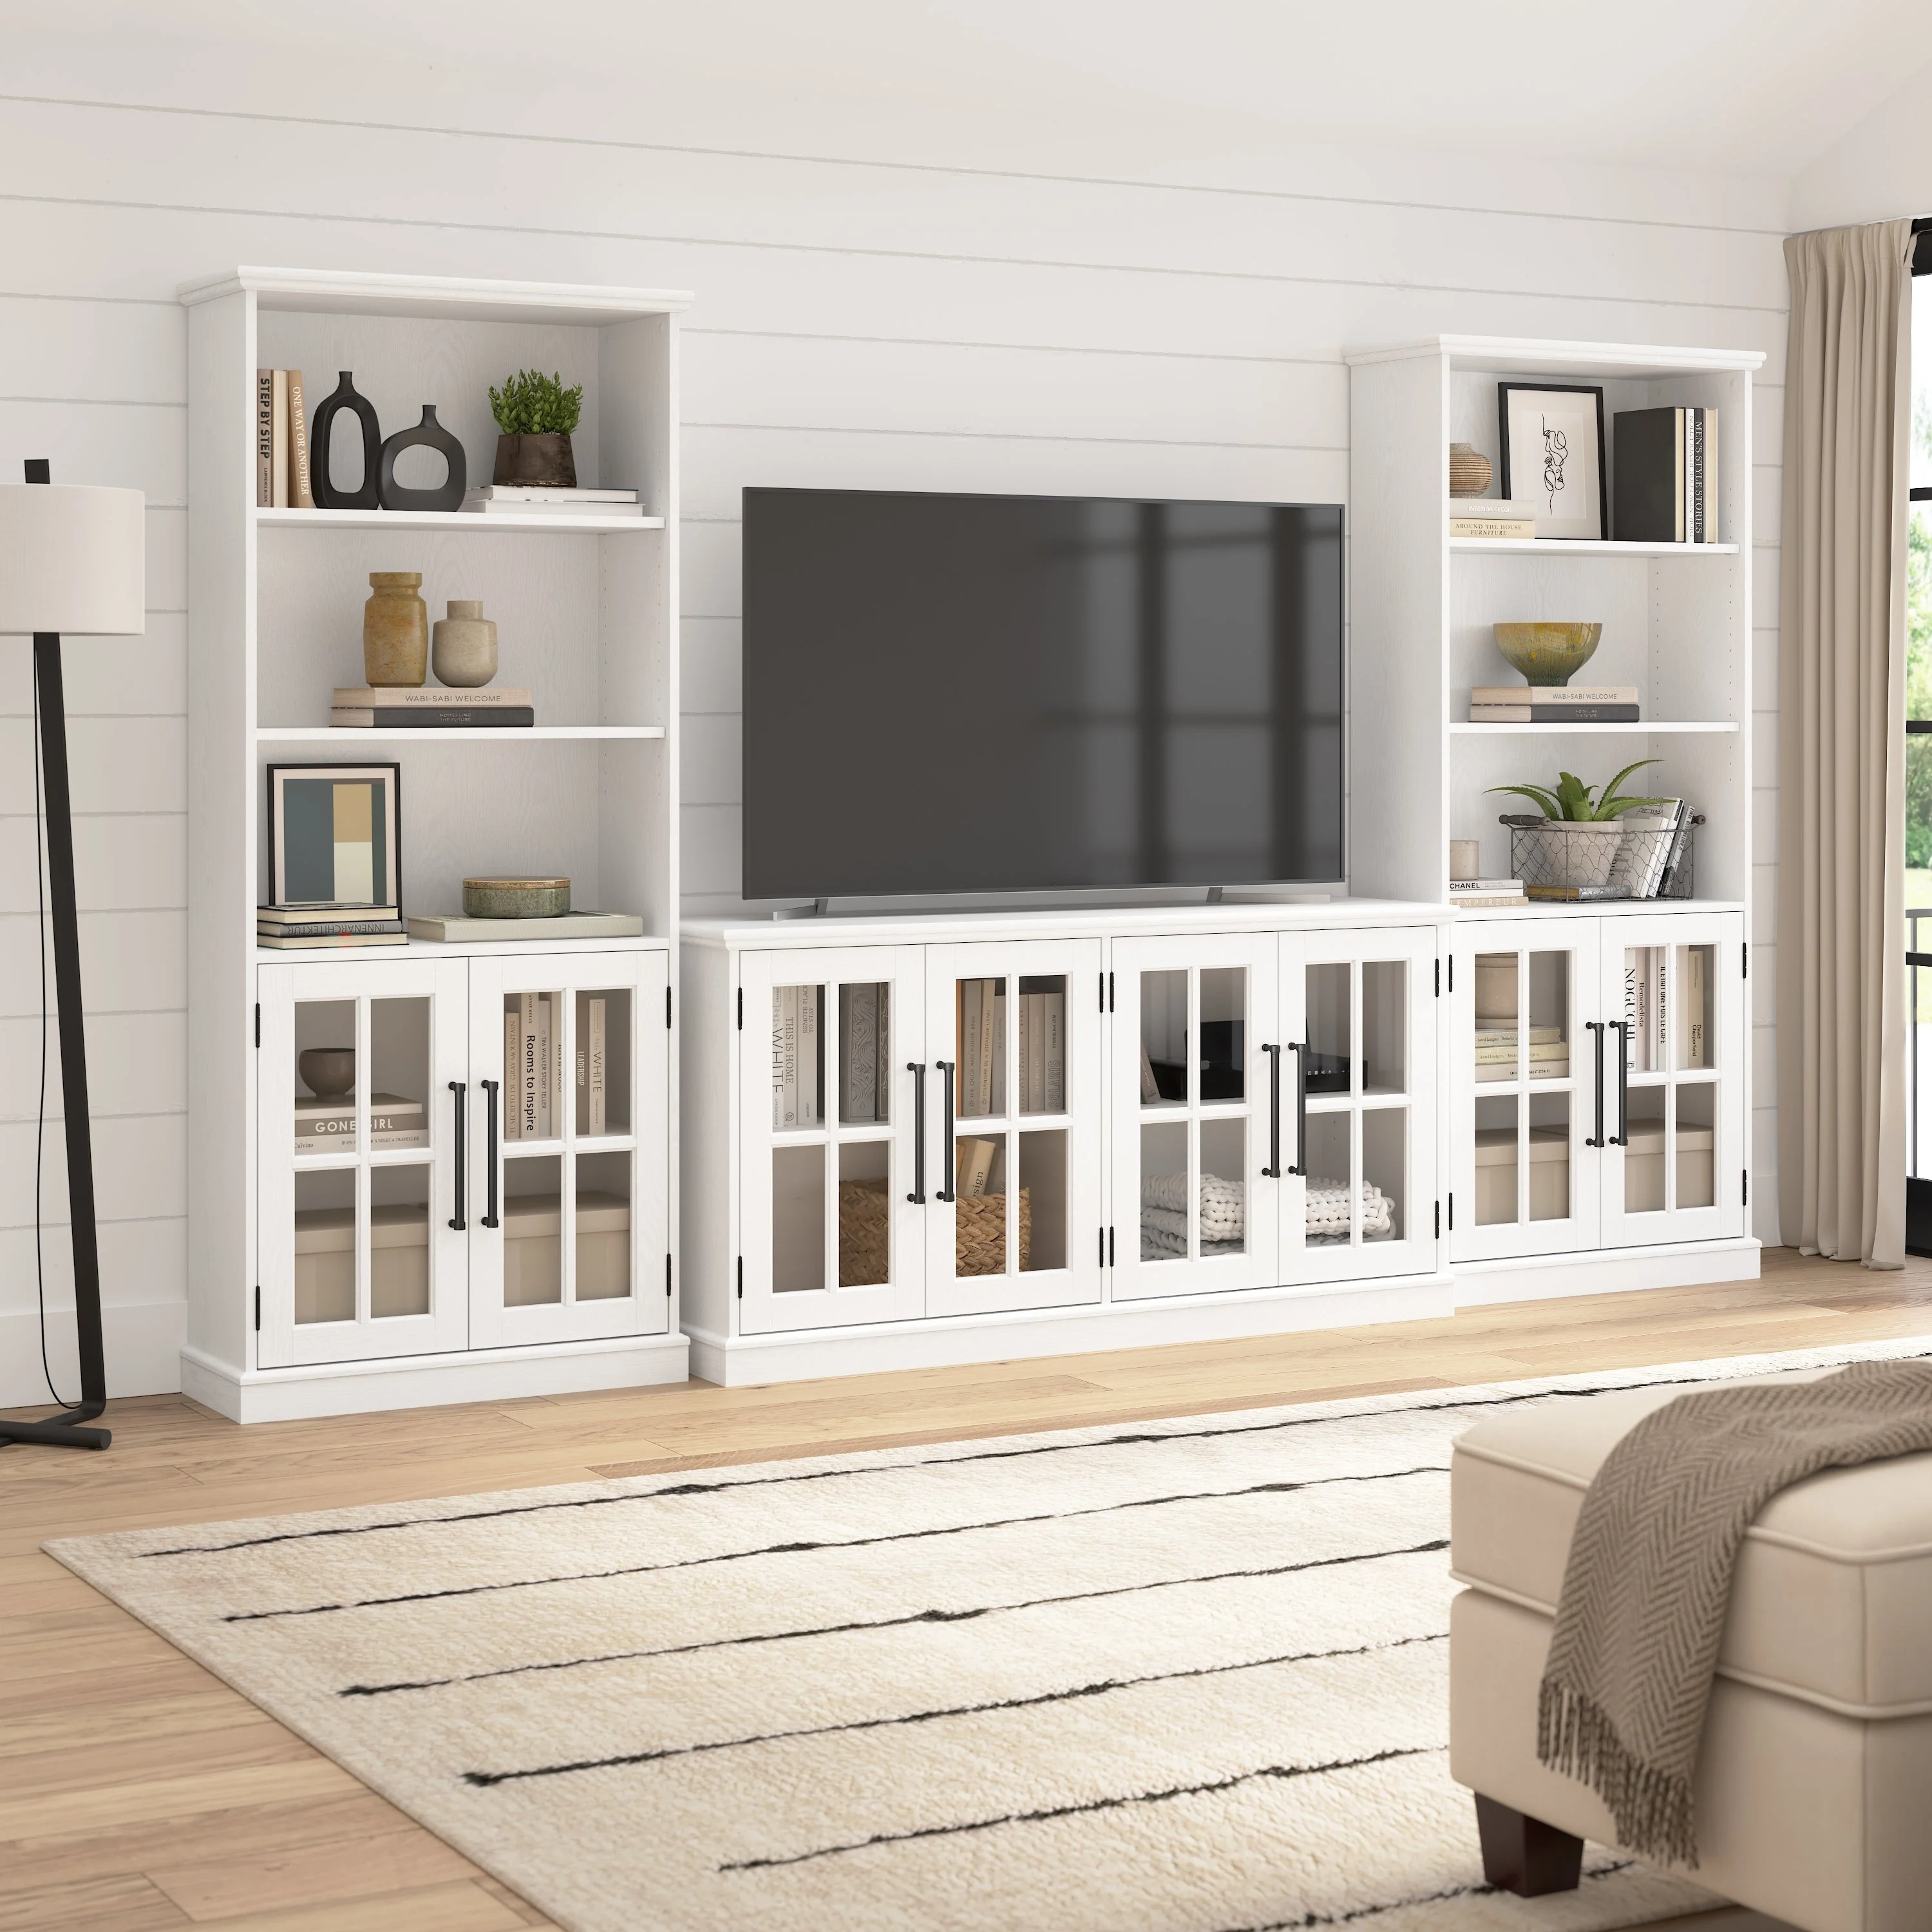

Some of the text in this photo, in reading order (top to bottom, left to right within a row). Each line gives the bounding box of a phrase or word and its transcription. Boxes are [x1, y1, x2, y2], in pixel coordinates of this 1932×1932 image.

[260, 378, 270, 459] STEP BY STEP
[293, 386, 309, 496] ONE WAY OR ANOTHER
[287, 923, 384, 935] INNENARCHITEKTUR
[1624, 969, 1635, 1039] NOGUCHI
[786, 1042, 793, 1052] IS
[808, 1024, 813, 1034] TO
[593, 1052, 601, 1092] WHITE
[773, 1028, 783, 1093] WHITE
[510, 1084, 515, 1094] DE
[524, 1035, 536, 1131] Rooms to Inspire
[1048, 1059, 1061, 1108] SOLARIS
[315, 1119, 393, 1133] GONE IRL
[972, 1171, 983, 1197] sign
